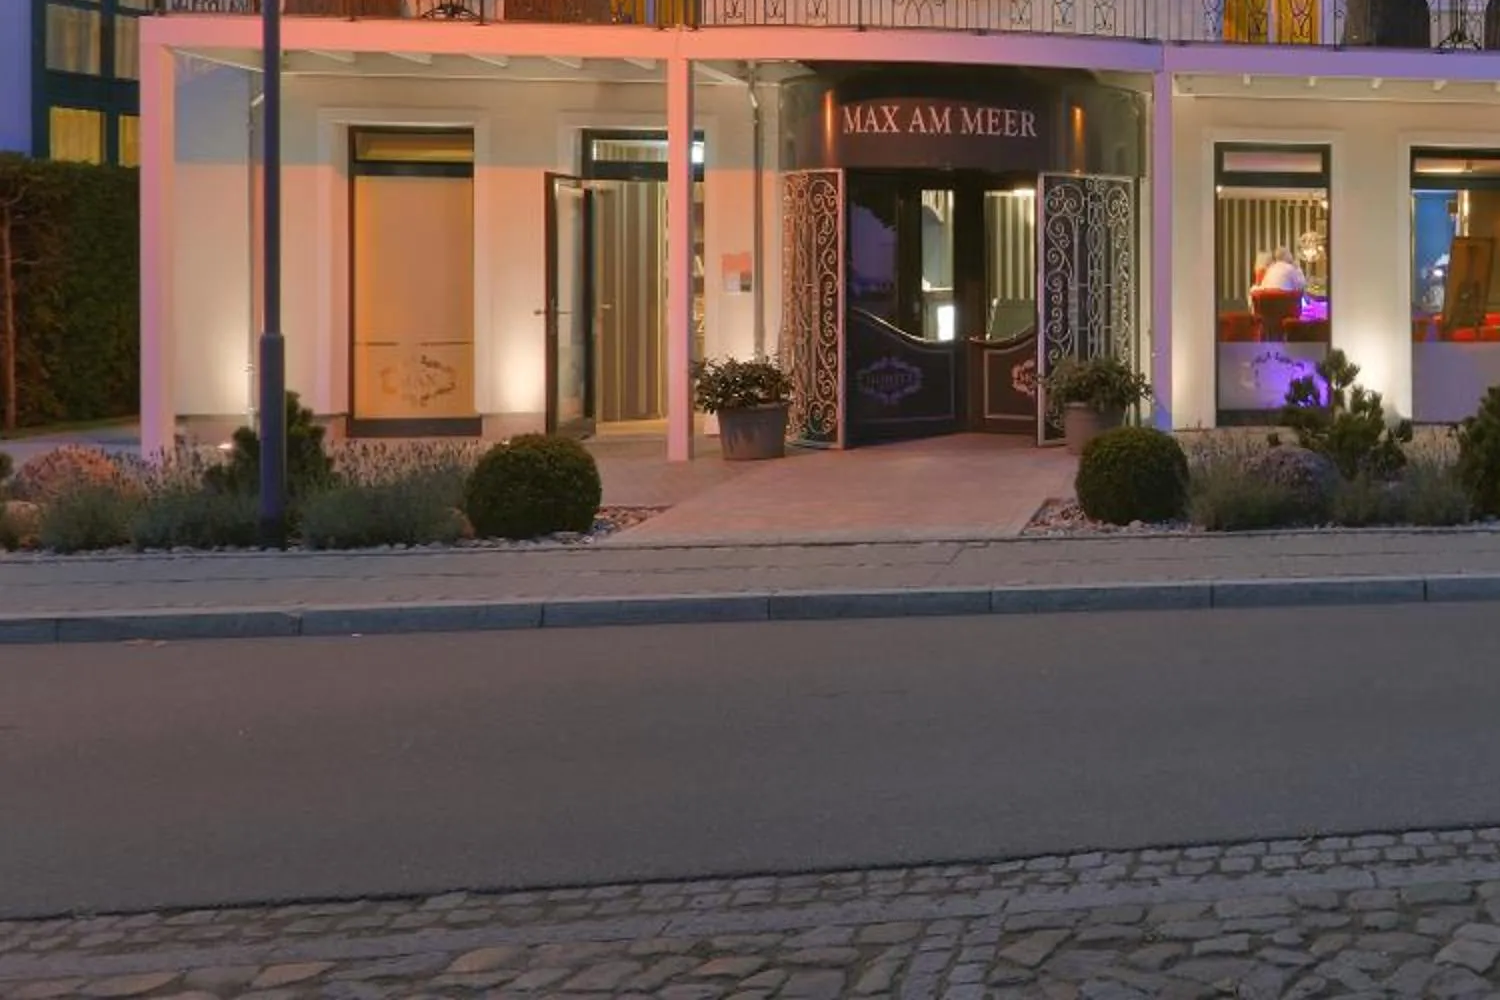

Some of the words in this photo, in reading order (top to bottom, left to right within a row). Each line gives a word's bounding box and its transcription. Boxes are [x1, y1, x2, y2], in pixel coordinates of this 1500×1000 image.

[843, 104, 901, 135] MAX
[908, 105, 953, 134] AM
[959, 106, 1038, 138] MEER
